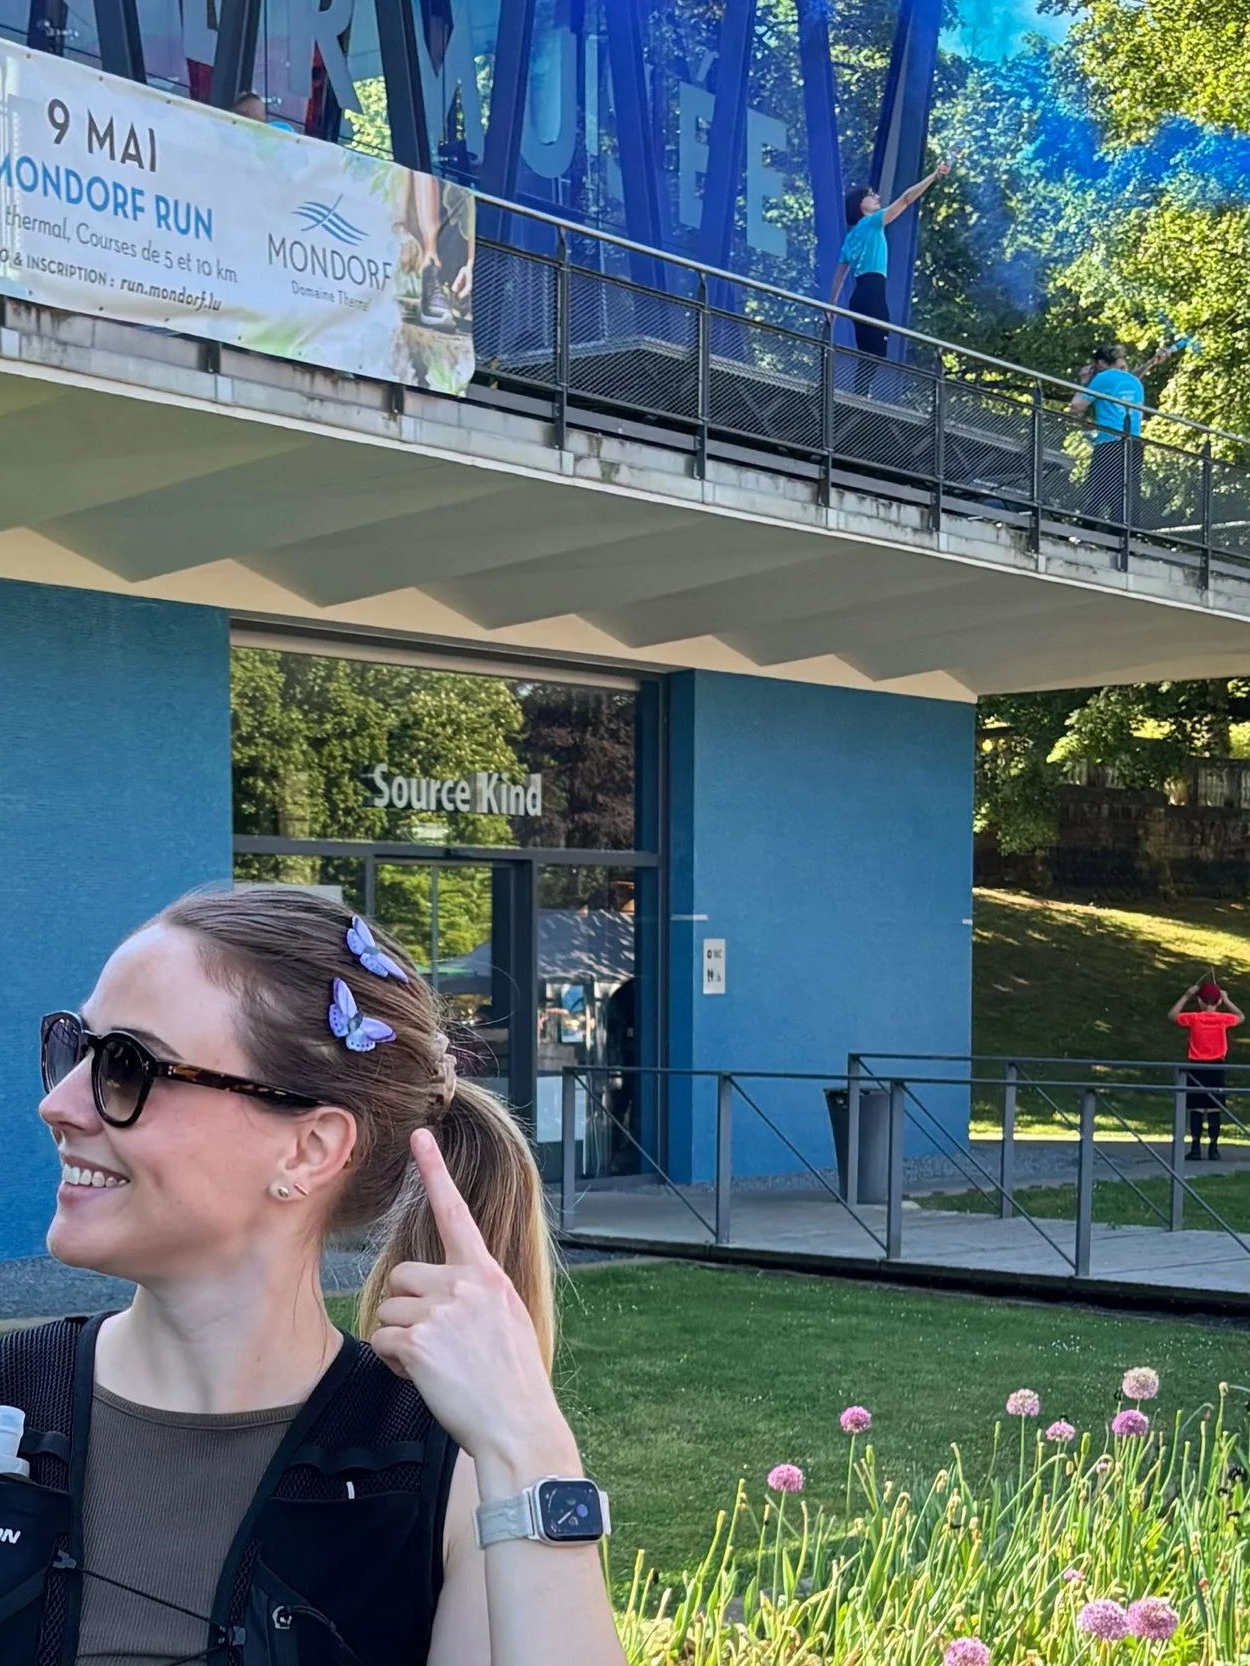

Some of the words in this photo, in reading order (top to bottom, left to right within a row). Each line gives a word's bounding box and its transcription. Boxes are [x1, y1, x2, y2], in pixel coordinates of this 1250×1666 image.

[47, 98, 70, 144] 9
[87, 108, 157, 172] MAI
[6, 203, 71, 243] thermal,
[76, 222, 138, 258] Courses
[142, 240, 160, 263] de
[165, 252, 174, 270] 5
[178, 253, 192, 272] et
[196, 258, 213, 277] 10
[217, 262, 238, 283] km
[155, 194, 213, 241] RUN
[13, 251, 23, 267] &
[26, 255, 107, 286] INSCRIPTION
[119, 276, 222, 312] run.mondorf.lu
[268, 232, 393, 292] MONDORF
[291, 279, 335, 303] Domaine
[373, 763, 470, 813] Source
[481, 772, 542, 816] Kind
